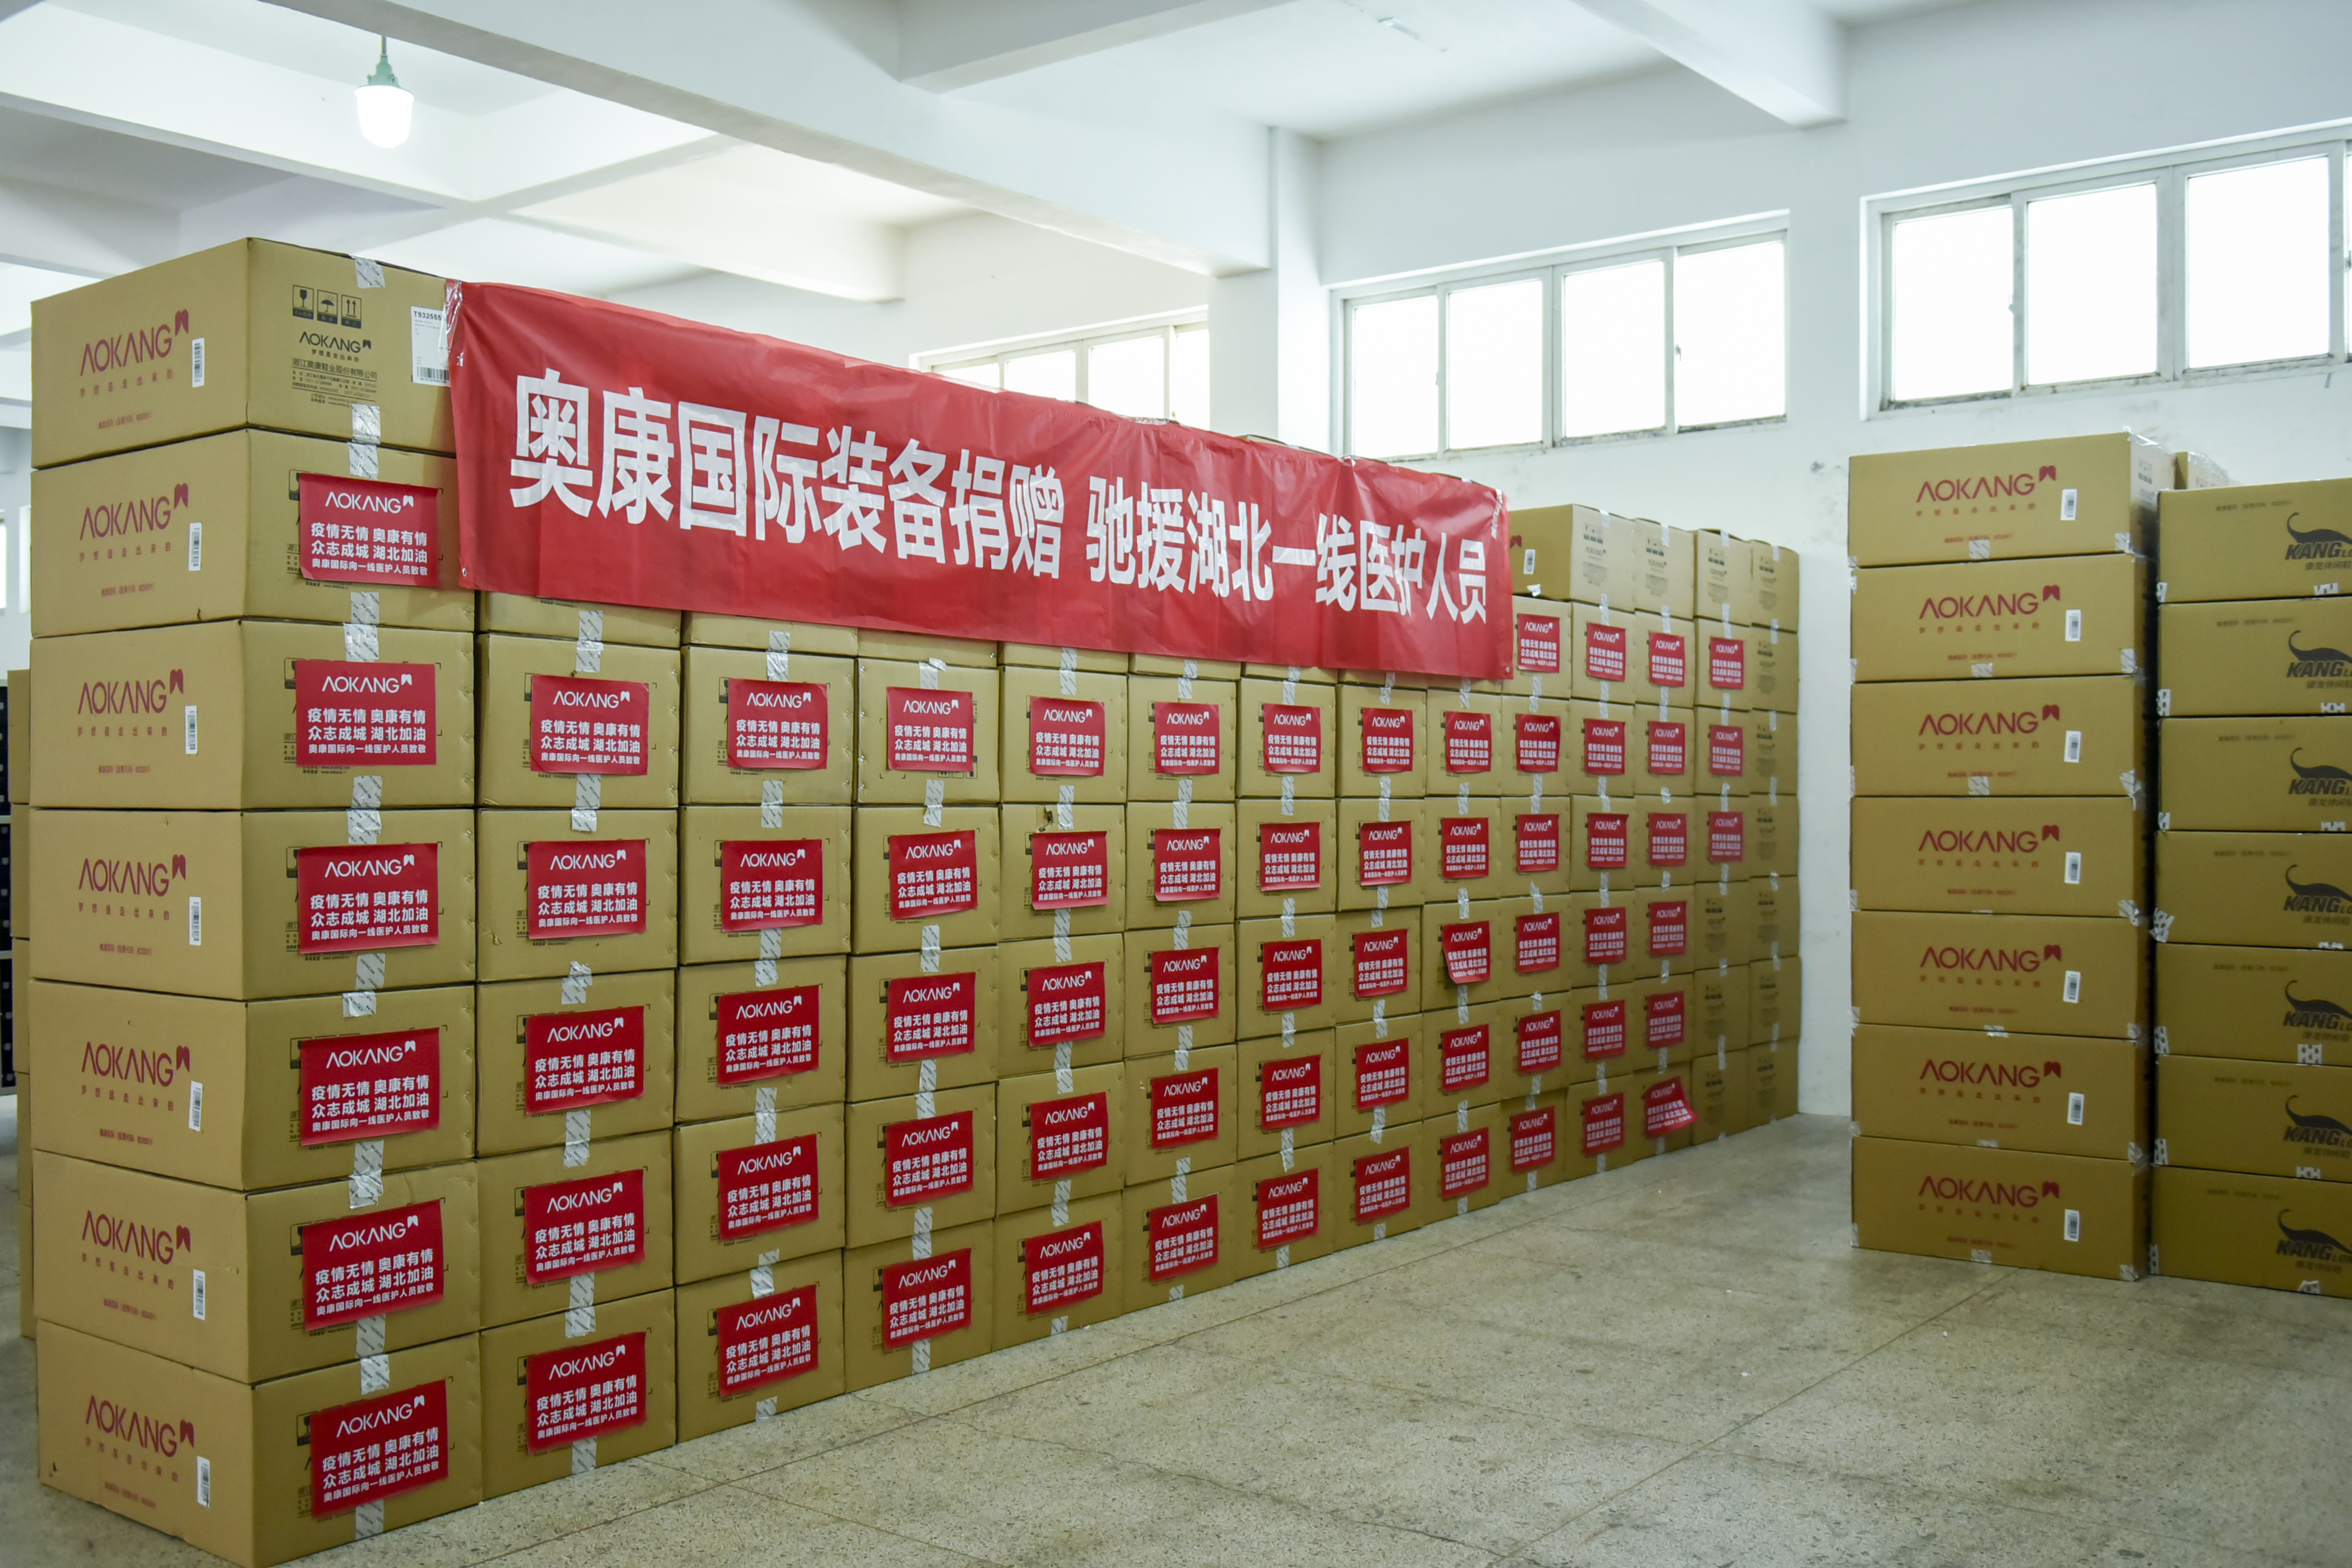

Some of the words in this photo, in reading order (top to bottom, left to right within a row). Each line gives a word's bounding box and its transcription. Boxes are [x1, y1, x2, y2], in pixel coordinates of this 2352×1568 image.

[80, 324, 172, 376] AOKANG
[299, 332, 361, 353] AOKANG
[510, 368, 1064, 579] 奥康国际装备捐赠
[1086, 476, 1487, 624] 驰援湖北一线医护人员
[1916, 474, 2035, 503] AOKANG
[325, 491, 402, 514] AOKANG
[80, 496, 171, 540] AOKANG
[311, 522, 369, 541] 疫情无情
[373, 527, 427, 546] 奥康有情
[311, 540, 369, 559] 众志成城
[373, 545, 427, 564] 湖北加油
[312, 558, 427, 576] 奥康国际向一线医护人员致敬
[1919, 592, 2039, 619] AOKANG
[1525, 622, 1549, 634] AOKANG
[322, 675, 400, 693] AOKANG
[78, 679, 167, 714] AOKANG
[553, 691, 619, 708] AOKANG
[746, 692, 802, 708] AOKANG
[903, 699, 951, 715] AOKANG
[308, 708, 367, 723] 疫情无情
[371, 708, 426, 724] 奥康有情
[736, 719, 778, 733] 疫情无情
[780, 721, 820, 735] 奥康有情
[1043, 708, 1086, 723] AOKANG
[1372, 716, 1401, 728] AOKANG
[1454, 720, 1480, 731] AOKANG
[1919, 711, 2039, 736] AOKANG
[308, 726, 367, 741] 众志成城
[371, 726, 426, 741] 湖北加油
[541, 719, 590, 736] 疫情无情
[593, 722, 639, 738] 奥康有情
[894, 724, 931, 738] 疫情无情
[933, 726, 967, 739] 奥康有情
[1524, 722, 1549, 733] AOKANG
[1592, 727, 1615, 737] AOKANG
[309, 743, 426, 754] 奥康国际向一线医护人员致敬
[541, 736, 590, 751] 众志成城
[593, 738, 639, 753] 湖北加油
[736, 734, 778, 748] 众志成城
[780, 735, 820, 750] 湖北加油
[895, 738, 931, 752] 众志成城
[933, 739, 967, 753] 湖北加油
[1036, 732, 1067, 744] 疫情无情
[1069, 733, 1099, 747] 奥康有情
[541, 752, 639, 765] 奥康国际向一线医护人员致敬
[1036, 744, 1067, 757] 众志成城
[1068, 746, 1099, 759] 湖北加油
[1166, 839, 1204, 851] AOKANG
[1919, 830, 2039, 854] AOKANG
[78, 859, 169, 897] AOKANG
[1160, 861, 1189, 873] 疫情无情
[1190, 860, 1215, 871] 奥康有情
[1160, 873, 1189, 885] 众志成城
[1190, 872, 1215, 883] 湖北加油
[1273, 949, 1306, 962] AOKANG
[1920, 946, 2040, 973] AOKANG
[903, 986, 952, 1003] AOKANG
[736, 1000, 793, 1020] AOKANG
[894, 1013, 931, 1028] 疫情无情
[933, 1009, 968, 1024] 奥康有情
[547, 1022, 613, 1043] AOKANG
[726, 1029, 768, 1047] 疫情无情
[771, 1024, 812, 1042] 奥康有情
[894, 1027, 931, 1042] 众志成城
[933, 1023, 968, 1038] 湖北加油
[326, 1046, 403, 1069] AOKANG
[535, 1054, 584, 1073] 疫情无情
[588, 1048, 635, 1067] 奥康有情
[726, 1044, 768, 1062] 众志成城
[771, 1038, 812, 1056] 湖北加油
[1365, 1049, 1396, 1064] AOKANG
[82, 1042, 174, 1087] AOKANG
[726, 1053, 812, 1073] 奥康国际向一线医护人员致敬
[1920, 1059, 2040, 1088] AOKANG
[312, 1081, 370, 1101] 疫情无情
[374, 1074, 430, 1094] 奥康有情
[535, 1069, 584, 1089] 众志成城
[588, 1064, 635, 1083] 湖北加油
[535, 1080, 635, 1101] 奥康国际向一线医护人员致敬
[312, 1098, 371, 1119] 众志成城
[374, 1091, 429, 1112] 湖北加油
[1045, 1106, 1088, 1125] AOKANG
[312, 1109, 430, 1132] 奥康国际向一线医护人员致敬
[1037, 1132, 1070, 1149] 疫情无情
[1072, 1126, 1102, 1143] 奥康有情
[1037, 1145, 1070, 1162] 众志成城
[1072, 1139, 1103, 1155] 湖北加油
[1919, 1175, 2039, 1209] AOKANG
[82, 1210, 174, 1265] AOKANG
[898, 1265, 948, 1289] AOKANG
[889, 1295, 927, 1315] 疫情无情
[929, 1285, 964, 1305] 奥康有情
[736, 1303, 792, 1331] AOKANG
[890, 1308, 927, 1329] 众志成城
[929, 1298, 964, 1318] 湖北加油
[726, 1337, 769, 1359] 疫情无情
[771, 1324, 811, 1347] 奥康有情
[549, 1351, 615, 1380] AOKANG
[726, 1350, 769, 1374] 众志成城
[771, 1339, 811, 1362] 湖北加油
[727, 1353, 811, 1385] 奥康国际向一线医护人员致敬
[536, 1387, 586, 1412] 疫情无情
[590, 1374, 637, 1399] 奥康有情
[336, 1403, 413, 1438] AOKANG
[537, 1402, 587, 1428] 众志成城
[590, 1390, 637, 1414] 湖北加油
[86, 1395, 177, 1457] AOKANG
[538, 1406, 638, 1439] 奥康国际向一线医护人员致敬
[322, 1443, 381, 1472] 疫情无情
[384, 1427, 438, 1456] 奥康有情
[323, 1460, 381, 1490] 众志成城
[384, 1443, 438, 1472] 湖北加油
[324, 1460, 438, 1503] 奥康国际向一线医护人员致敬
